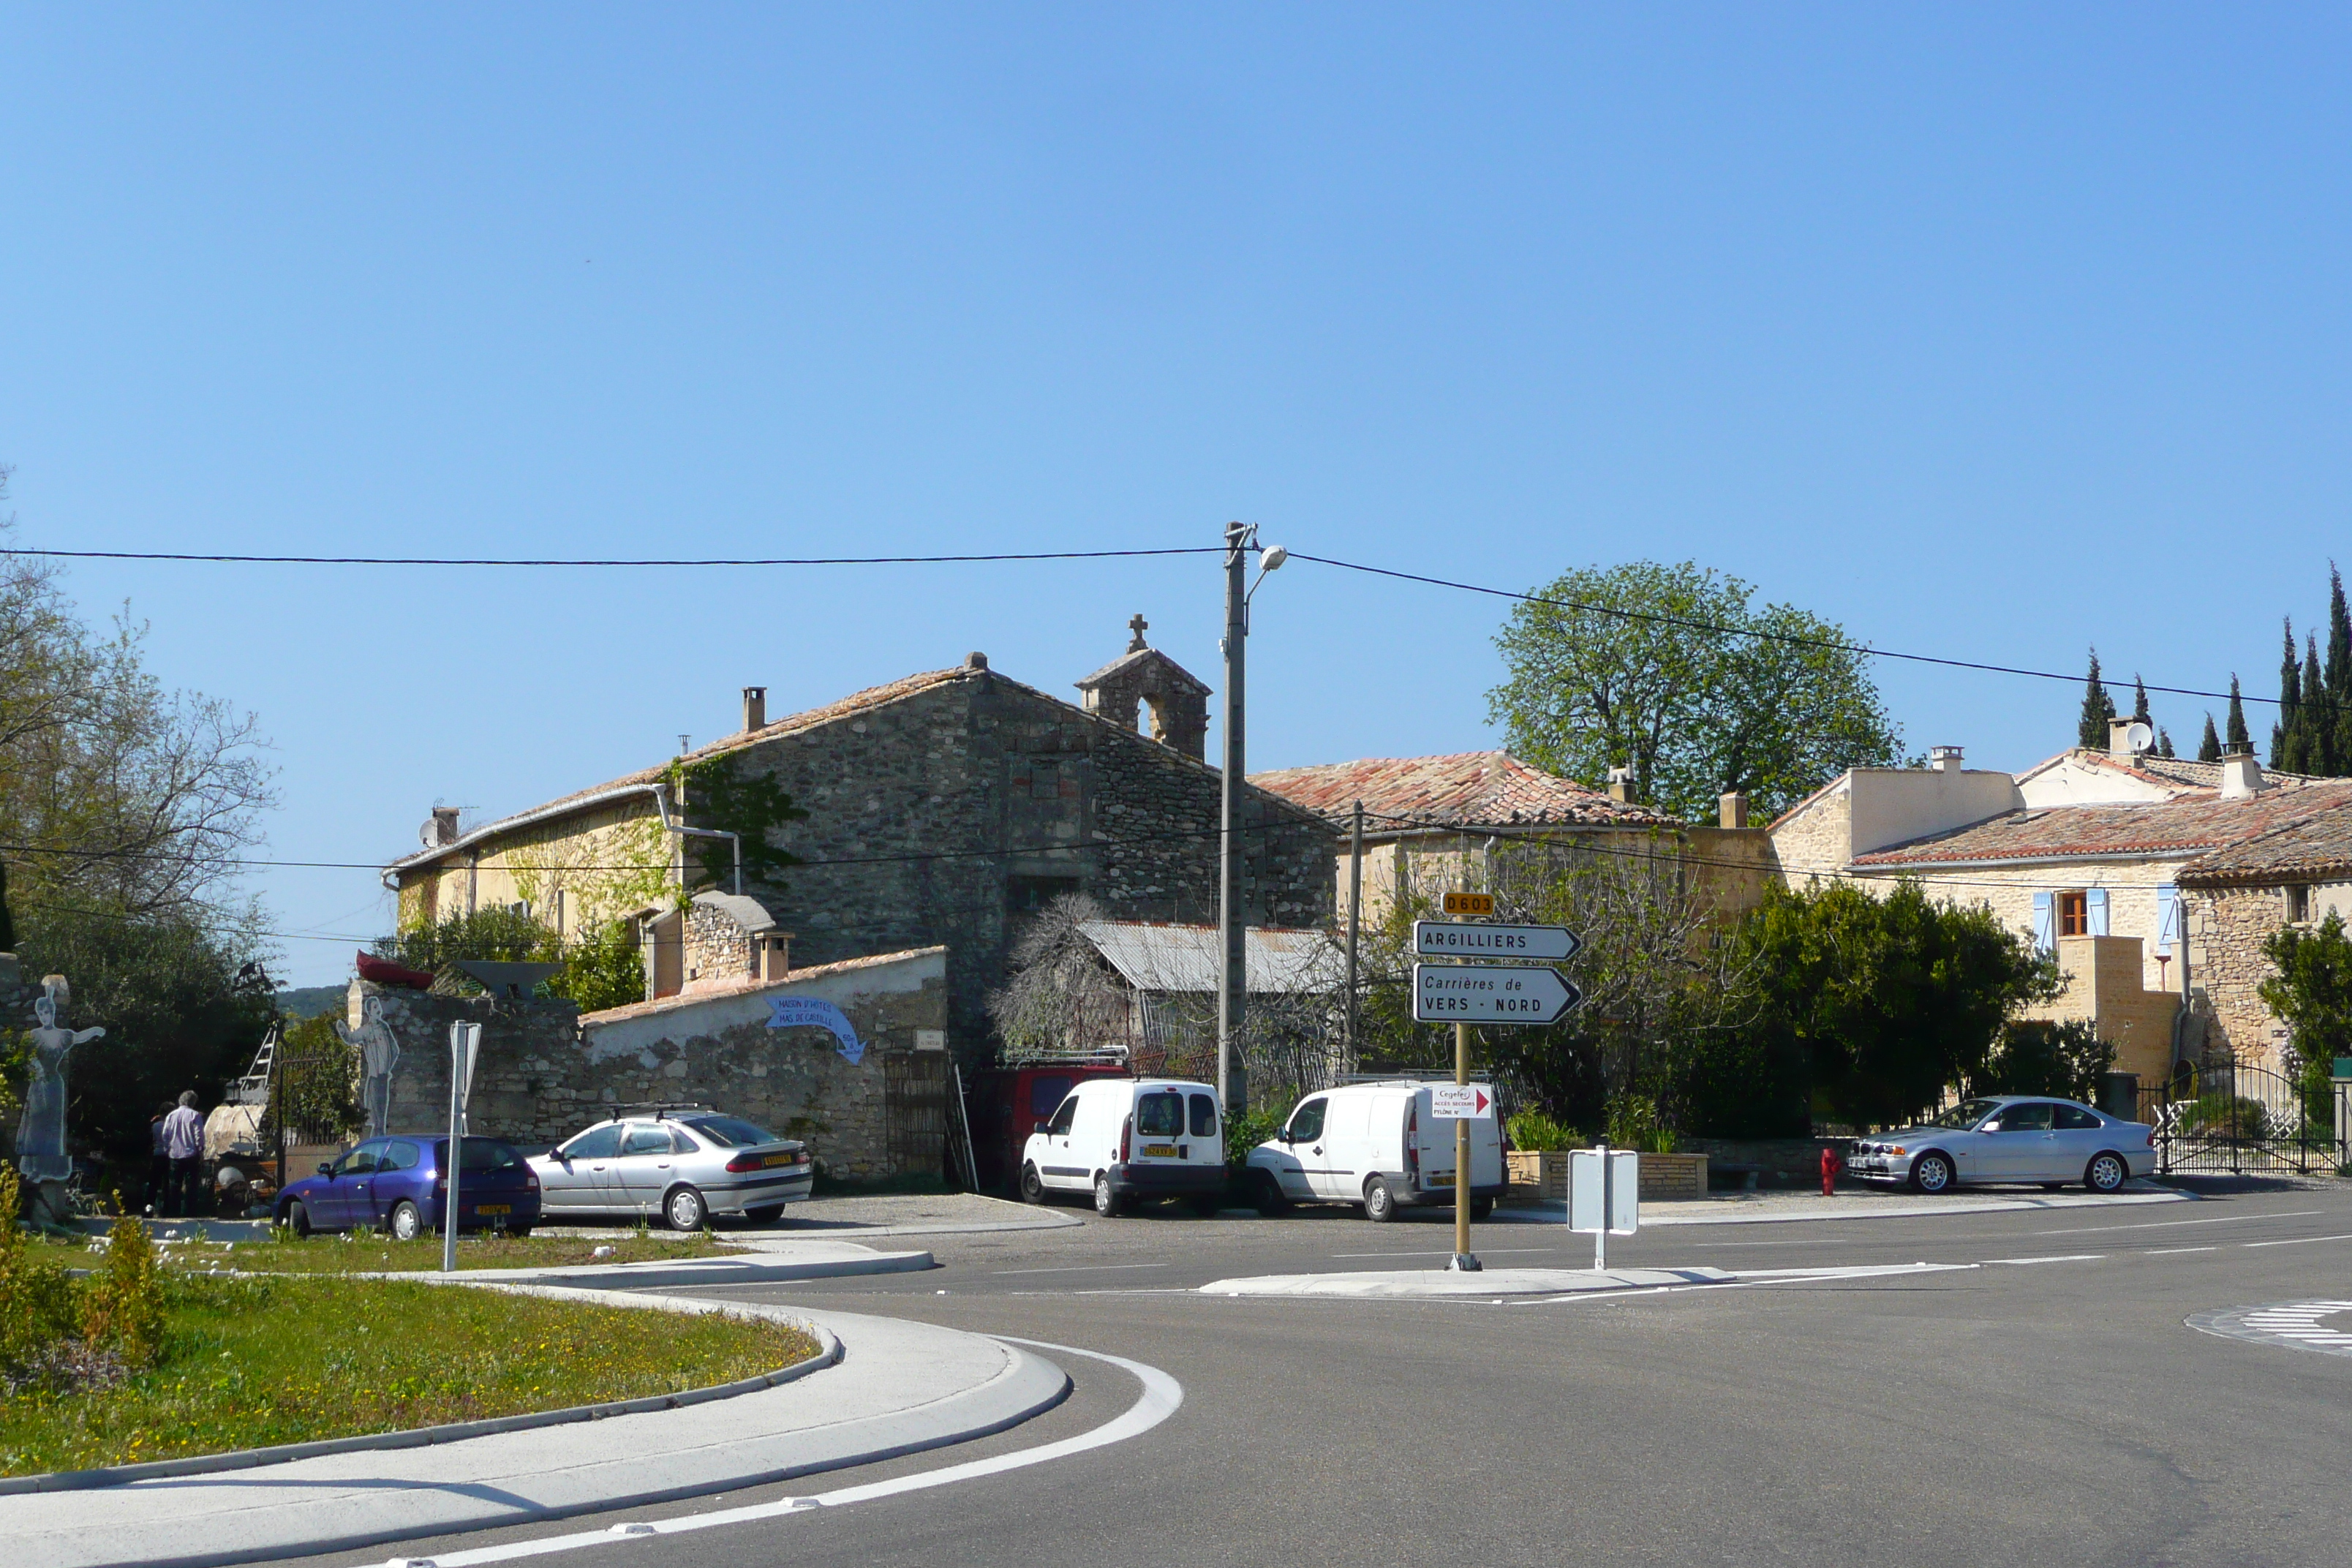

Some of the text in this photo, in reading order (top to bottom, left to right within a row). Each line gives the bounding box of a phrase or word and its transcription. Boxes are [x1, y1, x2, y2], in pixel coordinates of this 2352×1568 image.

[1425, 932, 1526, 948] ARGILLIERS
[1425, 976, 1522, 990] Carrières de
[779, 1000, 802, 1009] MAISON
[1425, 998, 1469, 1011] VERS
[1496, 998, 1541, 1012] NORD
[780, 1014, 793, 1023] MAS
[796, 1013, 804, 1022] DE
